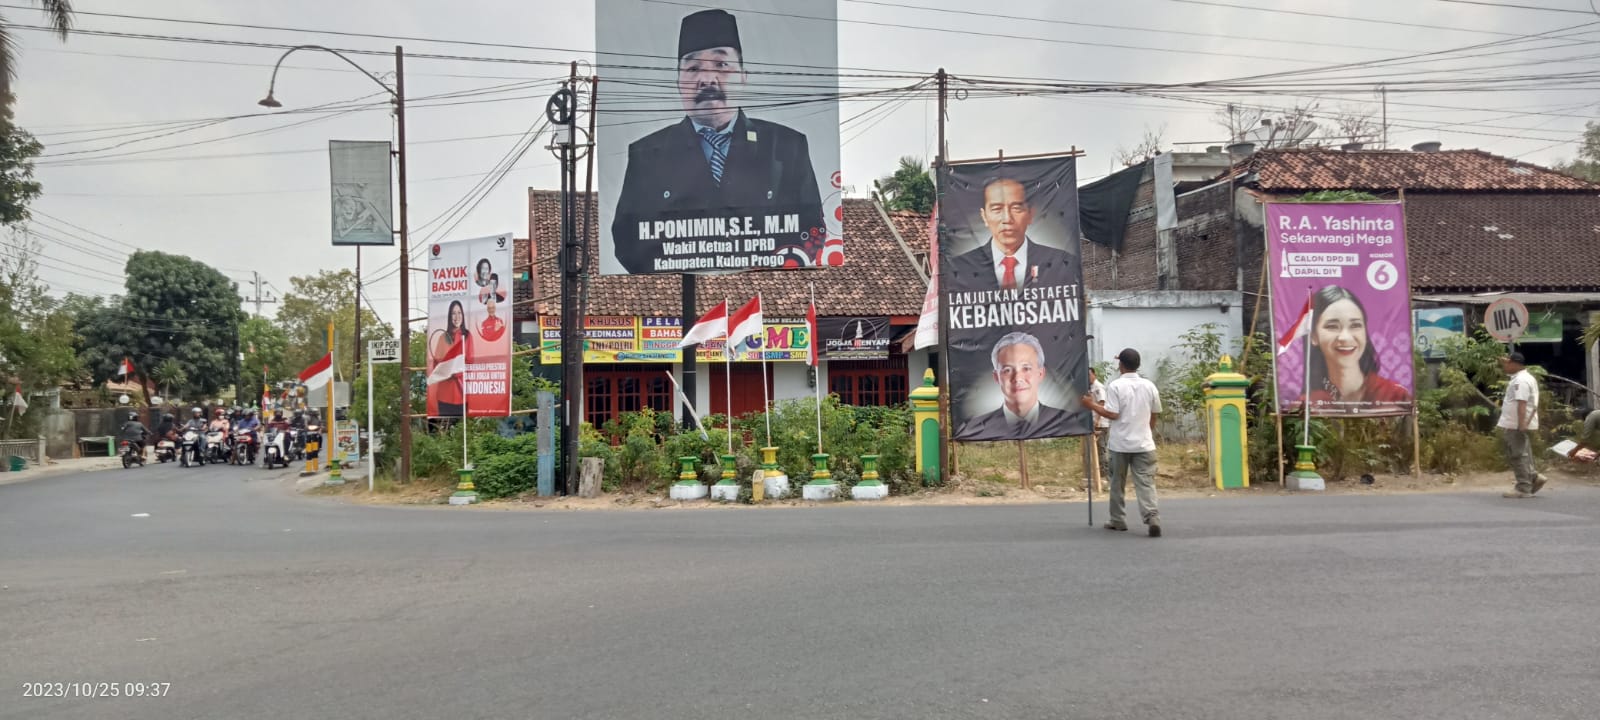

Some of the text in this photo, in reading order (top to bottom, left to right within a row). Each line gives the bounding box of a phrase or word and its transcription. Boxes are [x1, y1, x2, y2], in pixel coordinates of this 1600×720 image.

[638, 214, 799, 240] H.PONIMIN,S.E., M.M
[1280, 216, 1394, 230] R.A. Yashinta
[662, 241, 696, 255] Wakil
[698, 240, 732, 253] Ketua
[744, 238, 776, 252] DPRD
[1280, 232, 1392, 246] Sekarwangi Mega
[654, 254, 784, 270] Kabupaten Kulon Progo
[432, 266, 468, 280] YAYUK
[1374, 264, 1390, 285] 6
[432, 280, 468, 292] BASUKI
[949, 284, 1078, 305] LANJUTKAN ESTAFET
[590, 317, 632, 325] KHUSUS
[950, 298, 1080, 329] KEBANGSAAN
[372, 341, 384, 349] IKIP
